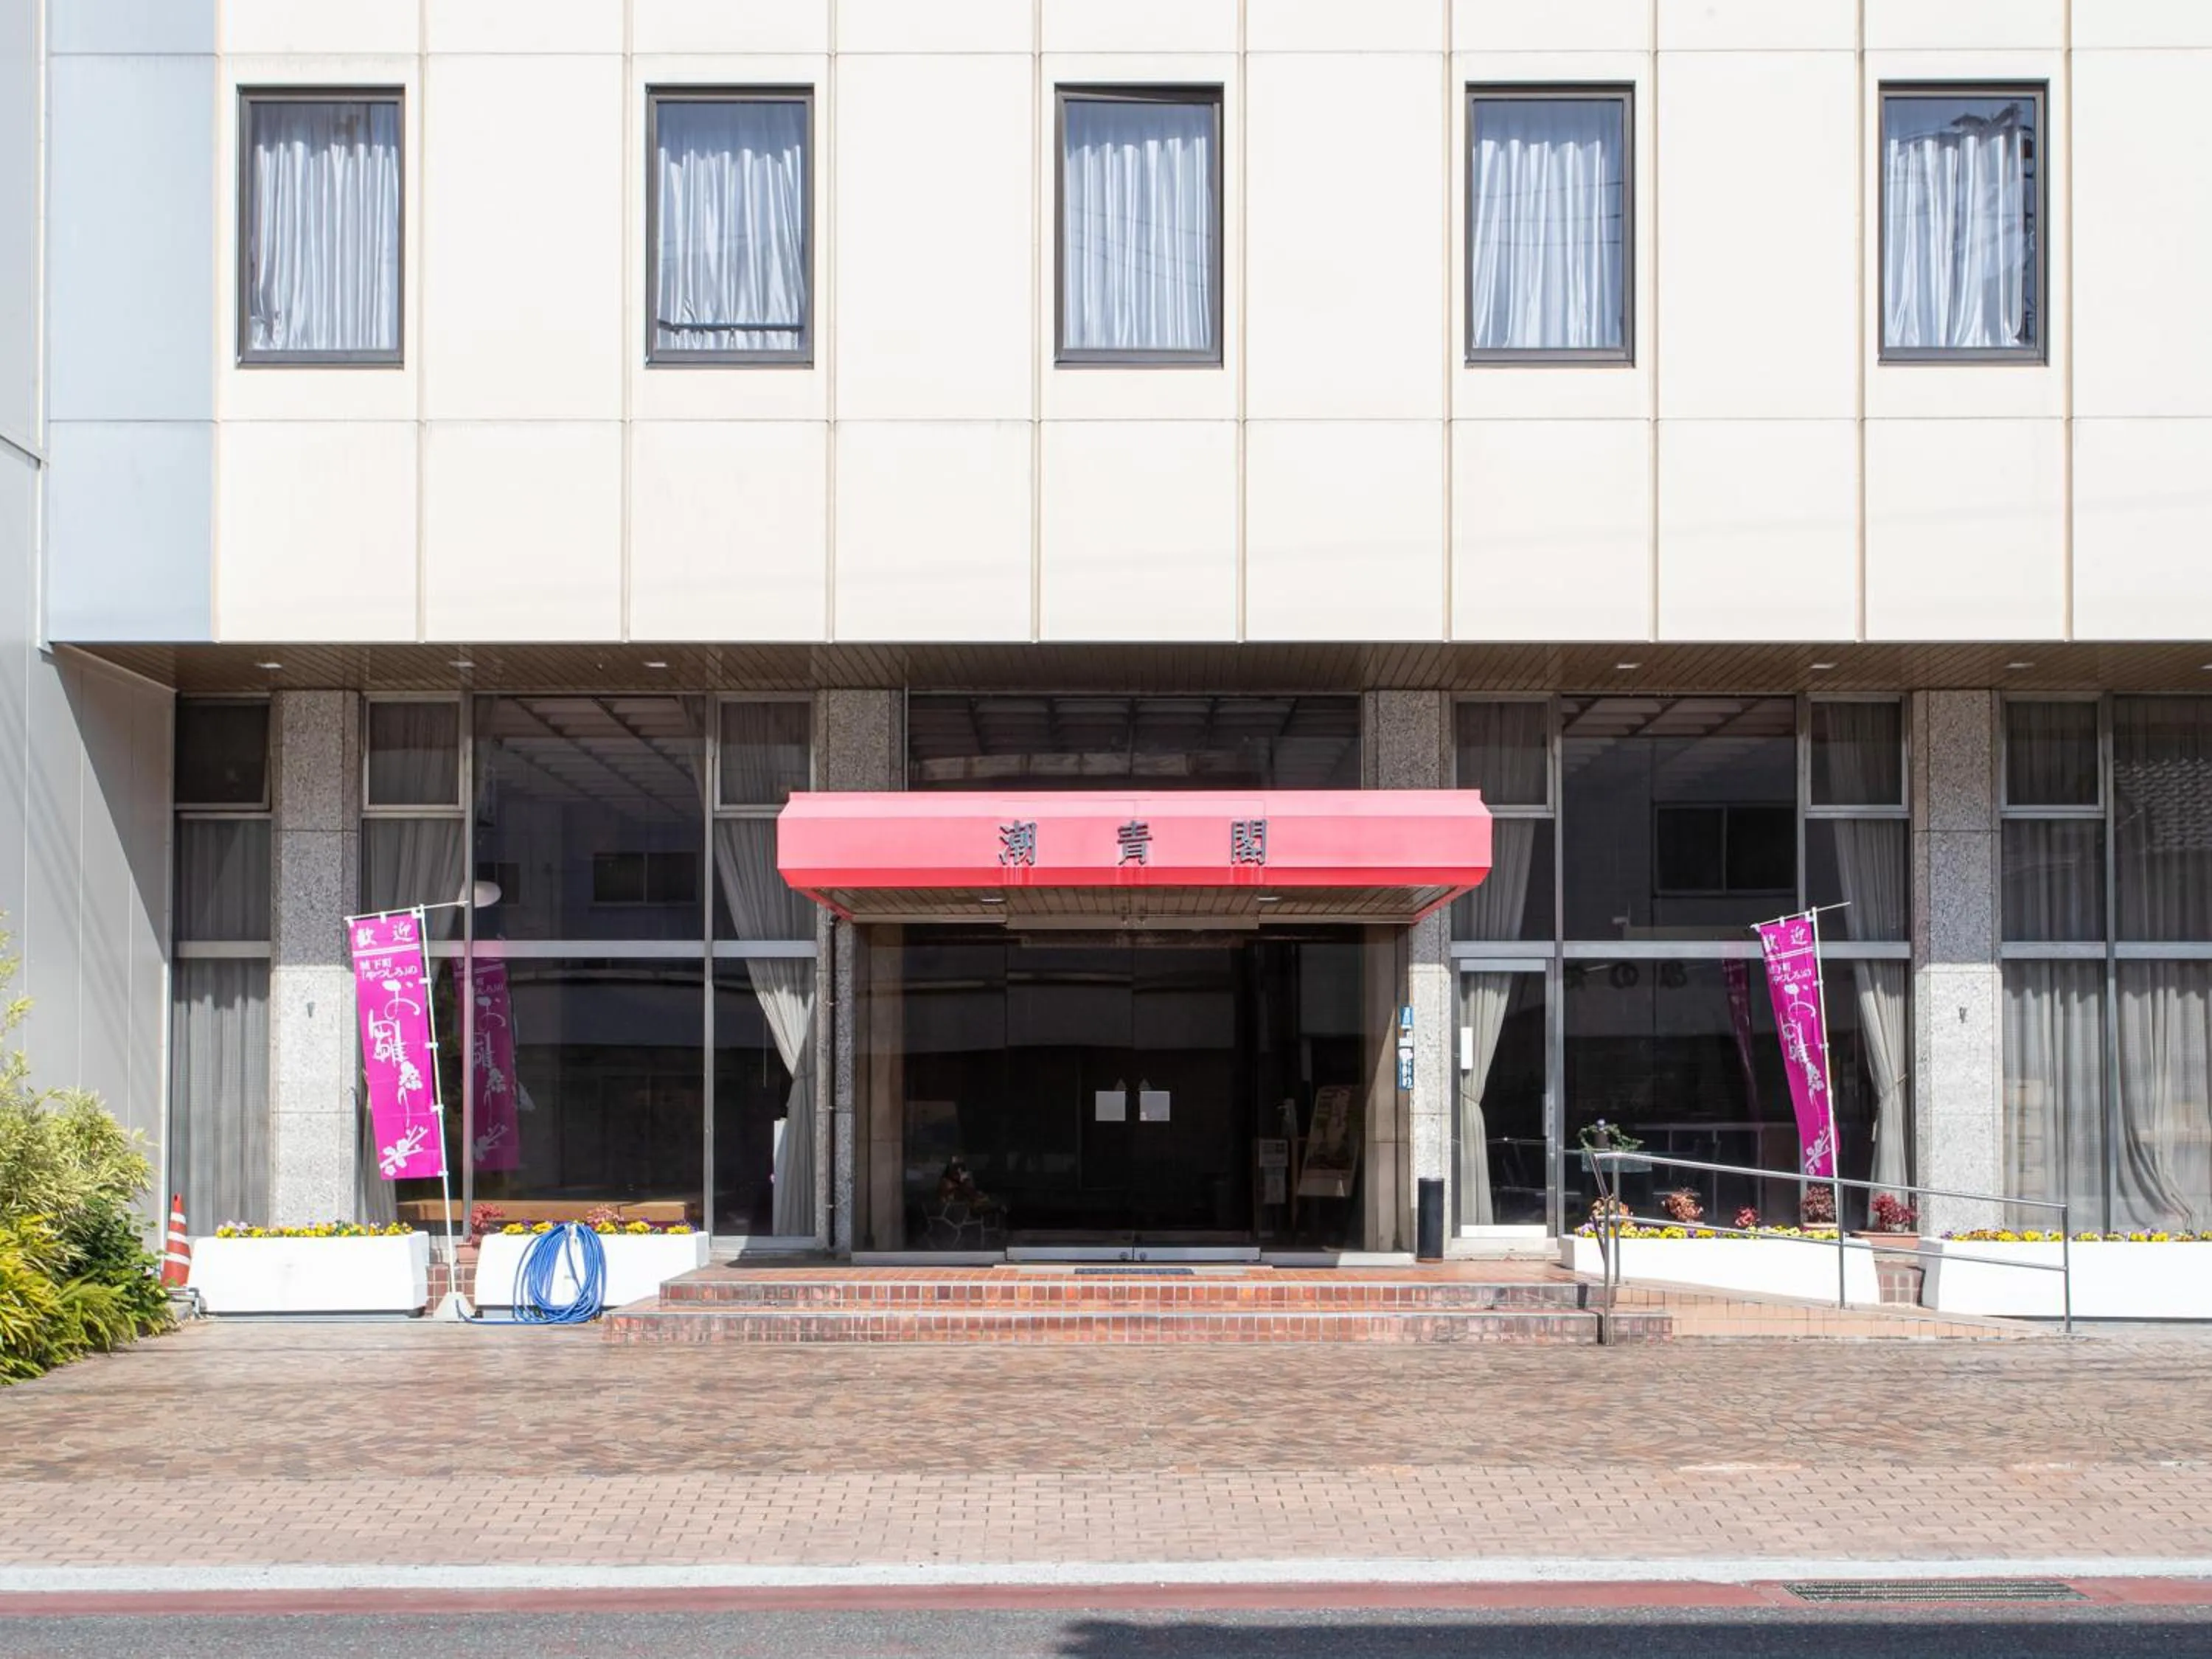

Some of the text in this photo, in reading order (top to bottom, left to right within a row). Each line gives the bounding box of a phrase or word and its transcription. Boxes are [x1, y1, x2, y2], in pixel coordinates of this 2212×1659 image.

[999, 819, 1266, 866] 潮青閣
[357, 921, 415, 948] 歓迎
